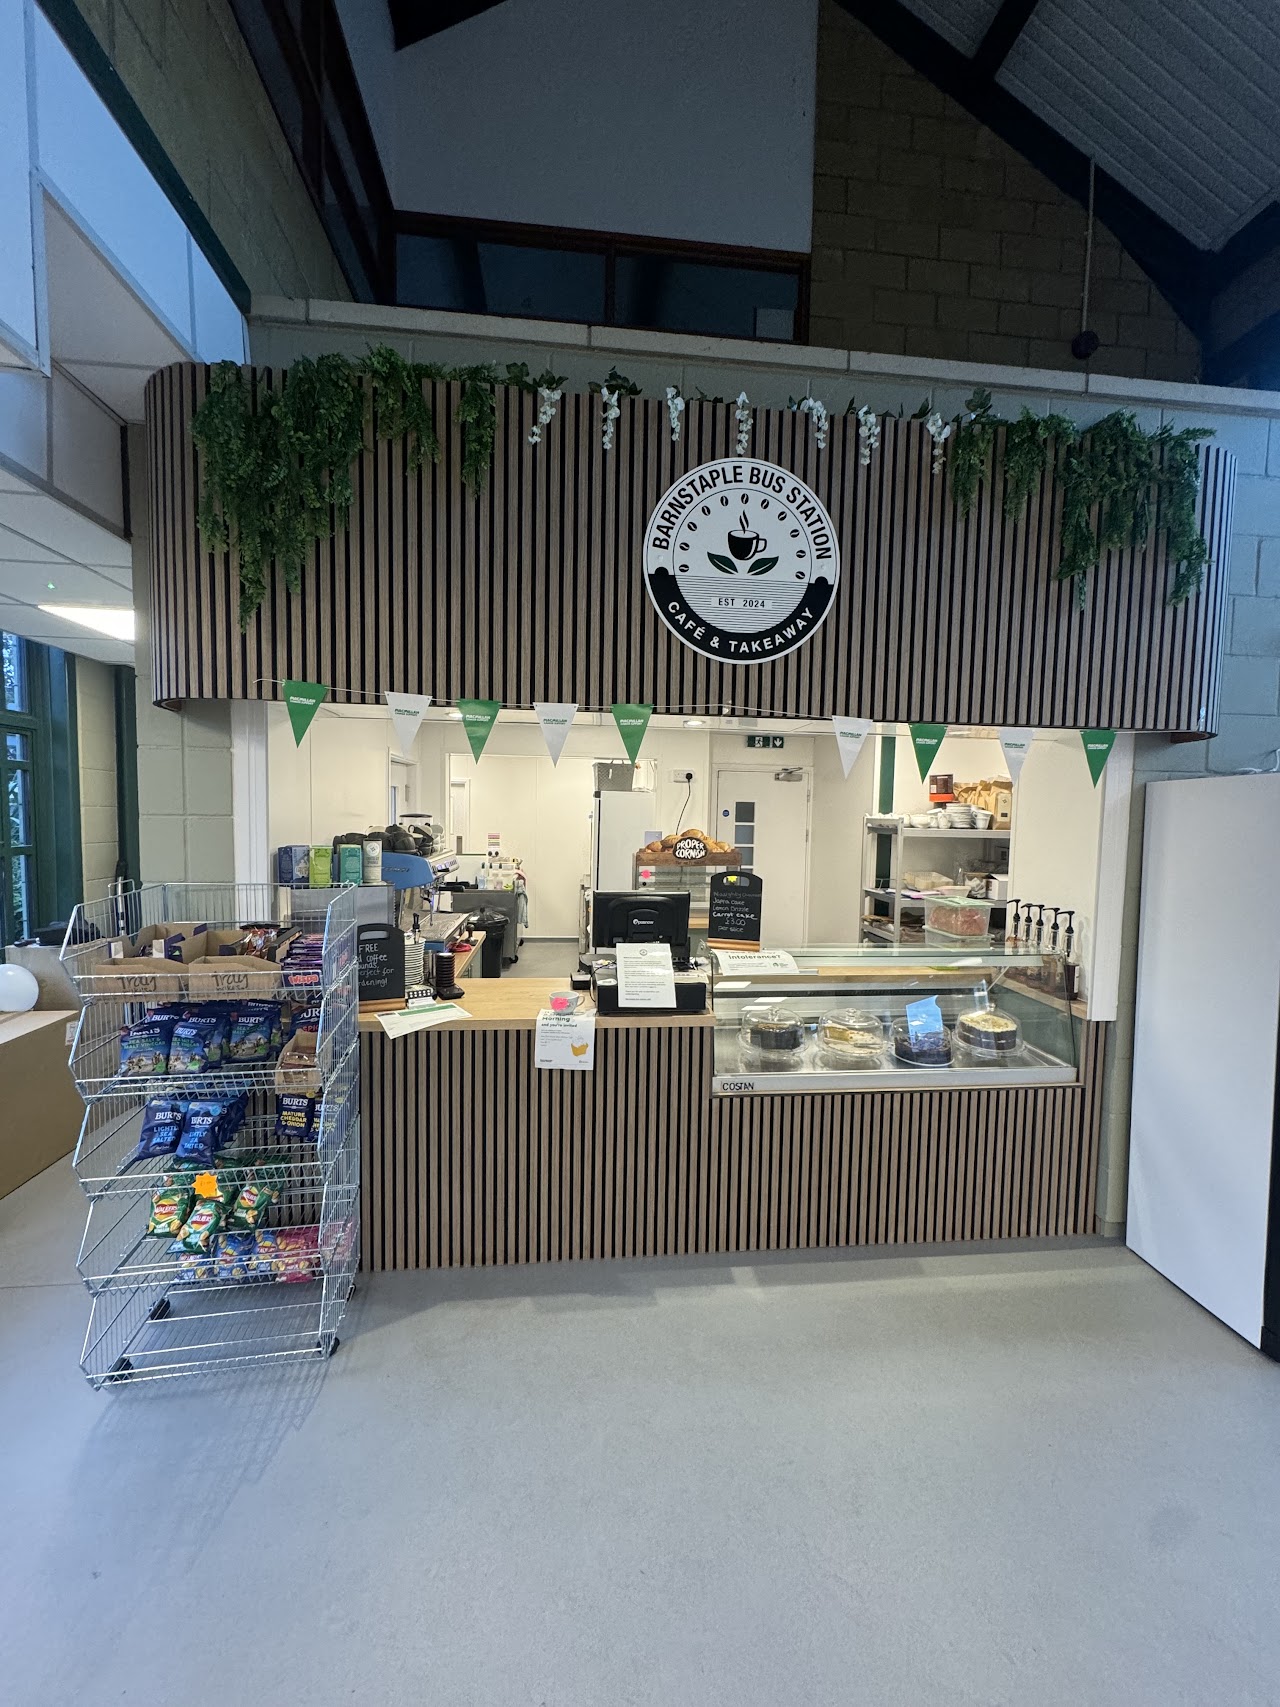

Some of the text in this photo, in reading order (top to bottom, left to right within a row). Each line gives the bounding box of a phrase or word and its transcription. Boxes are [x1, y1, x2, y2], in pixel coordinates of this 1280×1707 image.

[652, 465, 832, 560] BARNSTAPLE BUS STATION
[718, 597, 766, 608] EST 2024
[668, 601, 814, 653] CAFÉ & TAKEAWAY
[676, 839, 704, 850] PROPER
[675, 848, 706, 860] CORNISH
[358, 943, 379, 953] FREE
[366, 954, 388, 964] coffee
[359, 967, 395, 978] erfect for
[288, 974, 319, 985] Wispa
[722, 1082, 755, 1091] COSTAN
[282, 1097, 309, 1106] BURTS
[280, 1115, 307, 1123] CHEDDAR
[281, 1110, 306, 1118] MATURE
